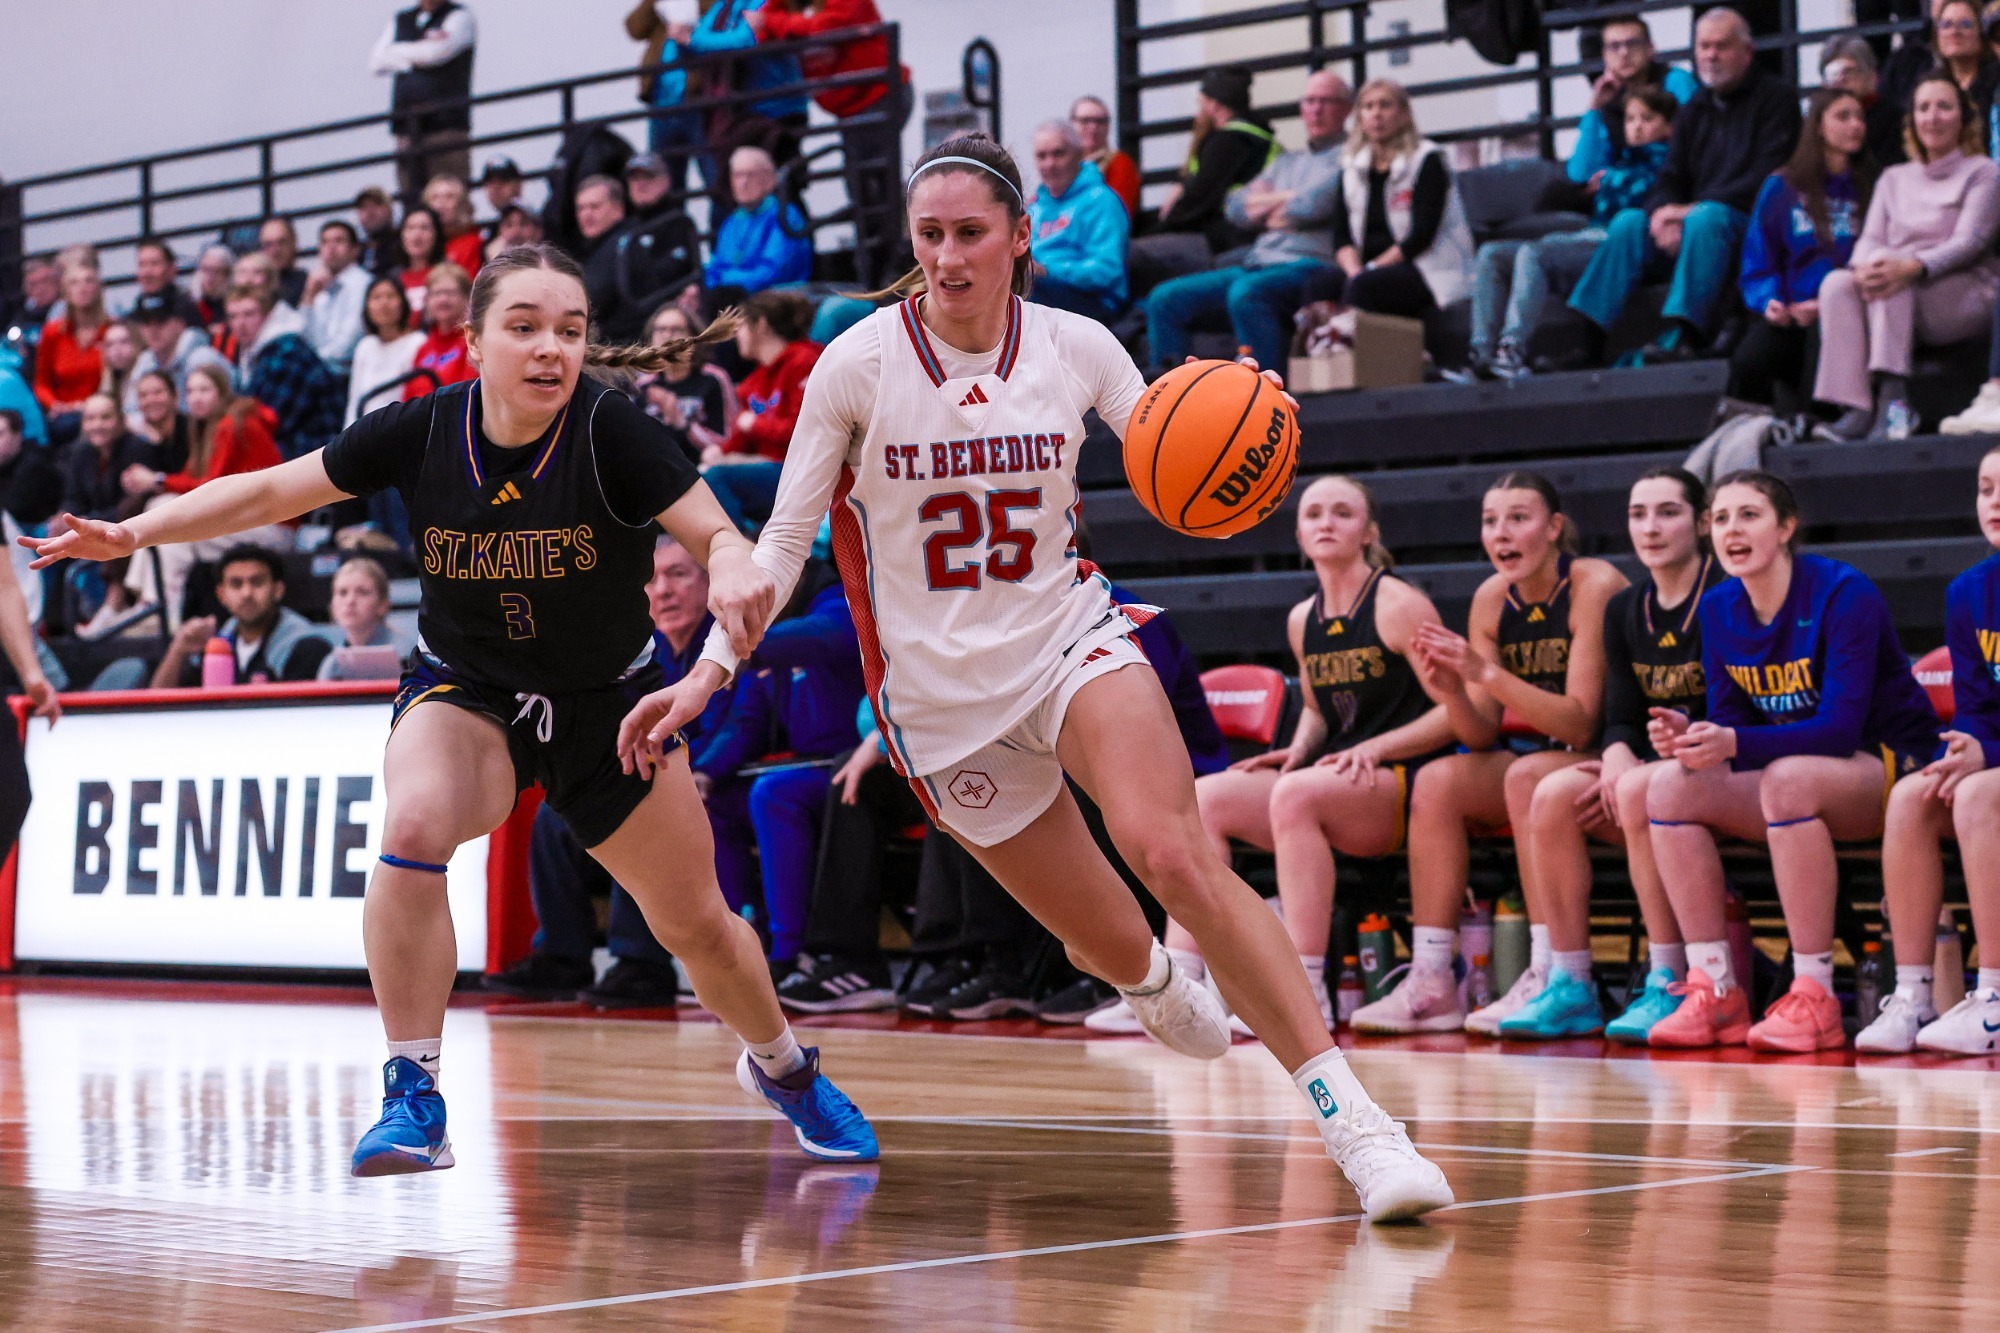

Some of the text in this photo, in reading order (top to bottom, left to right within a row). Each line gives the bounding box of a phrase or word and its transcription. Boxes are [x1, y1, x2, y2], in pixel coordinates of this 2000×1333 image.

[884, 432, 1066, 481] ST. BENEDICT
[1209, 406, 1286, 507] Wilson
[917, 486, 1043, 592] 25
[500, 592, 537, 640] 3
[72, 775, 373, 898] BENNIE
